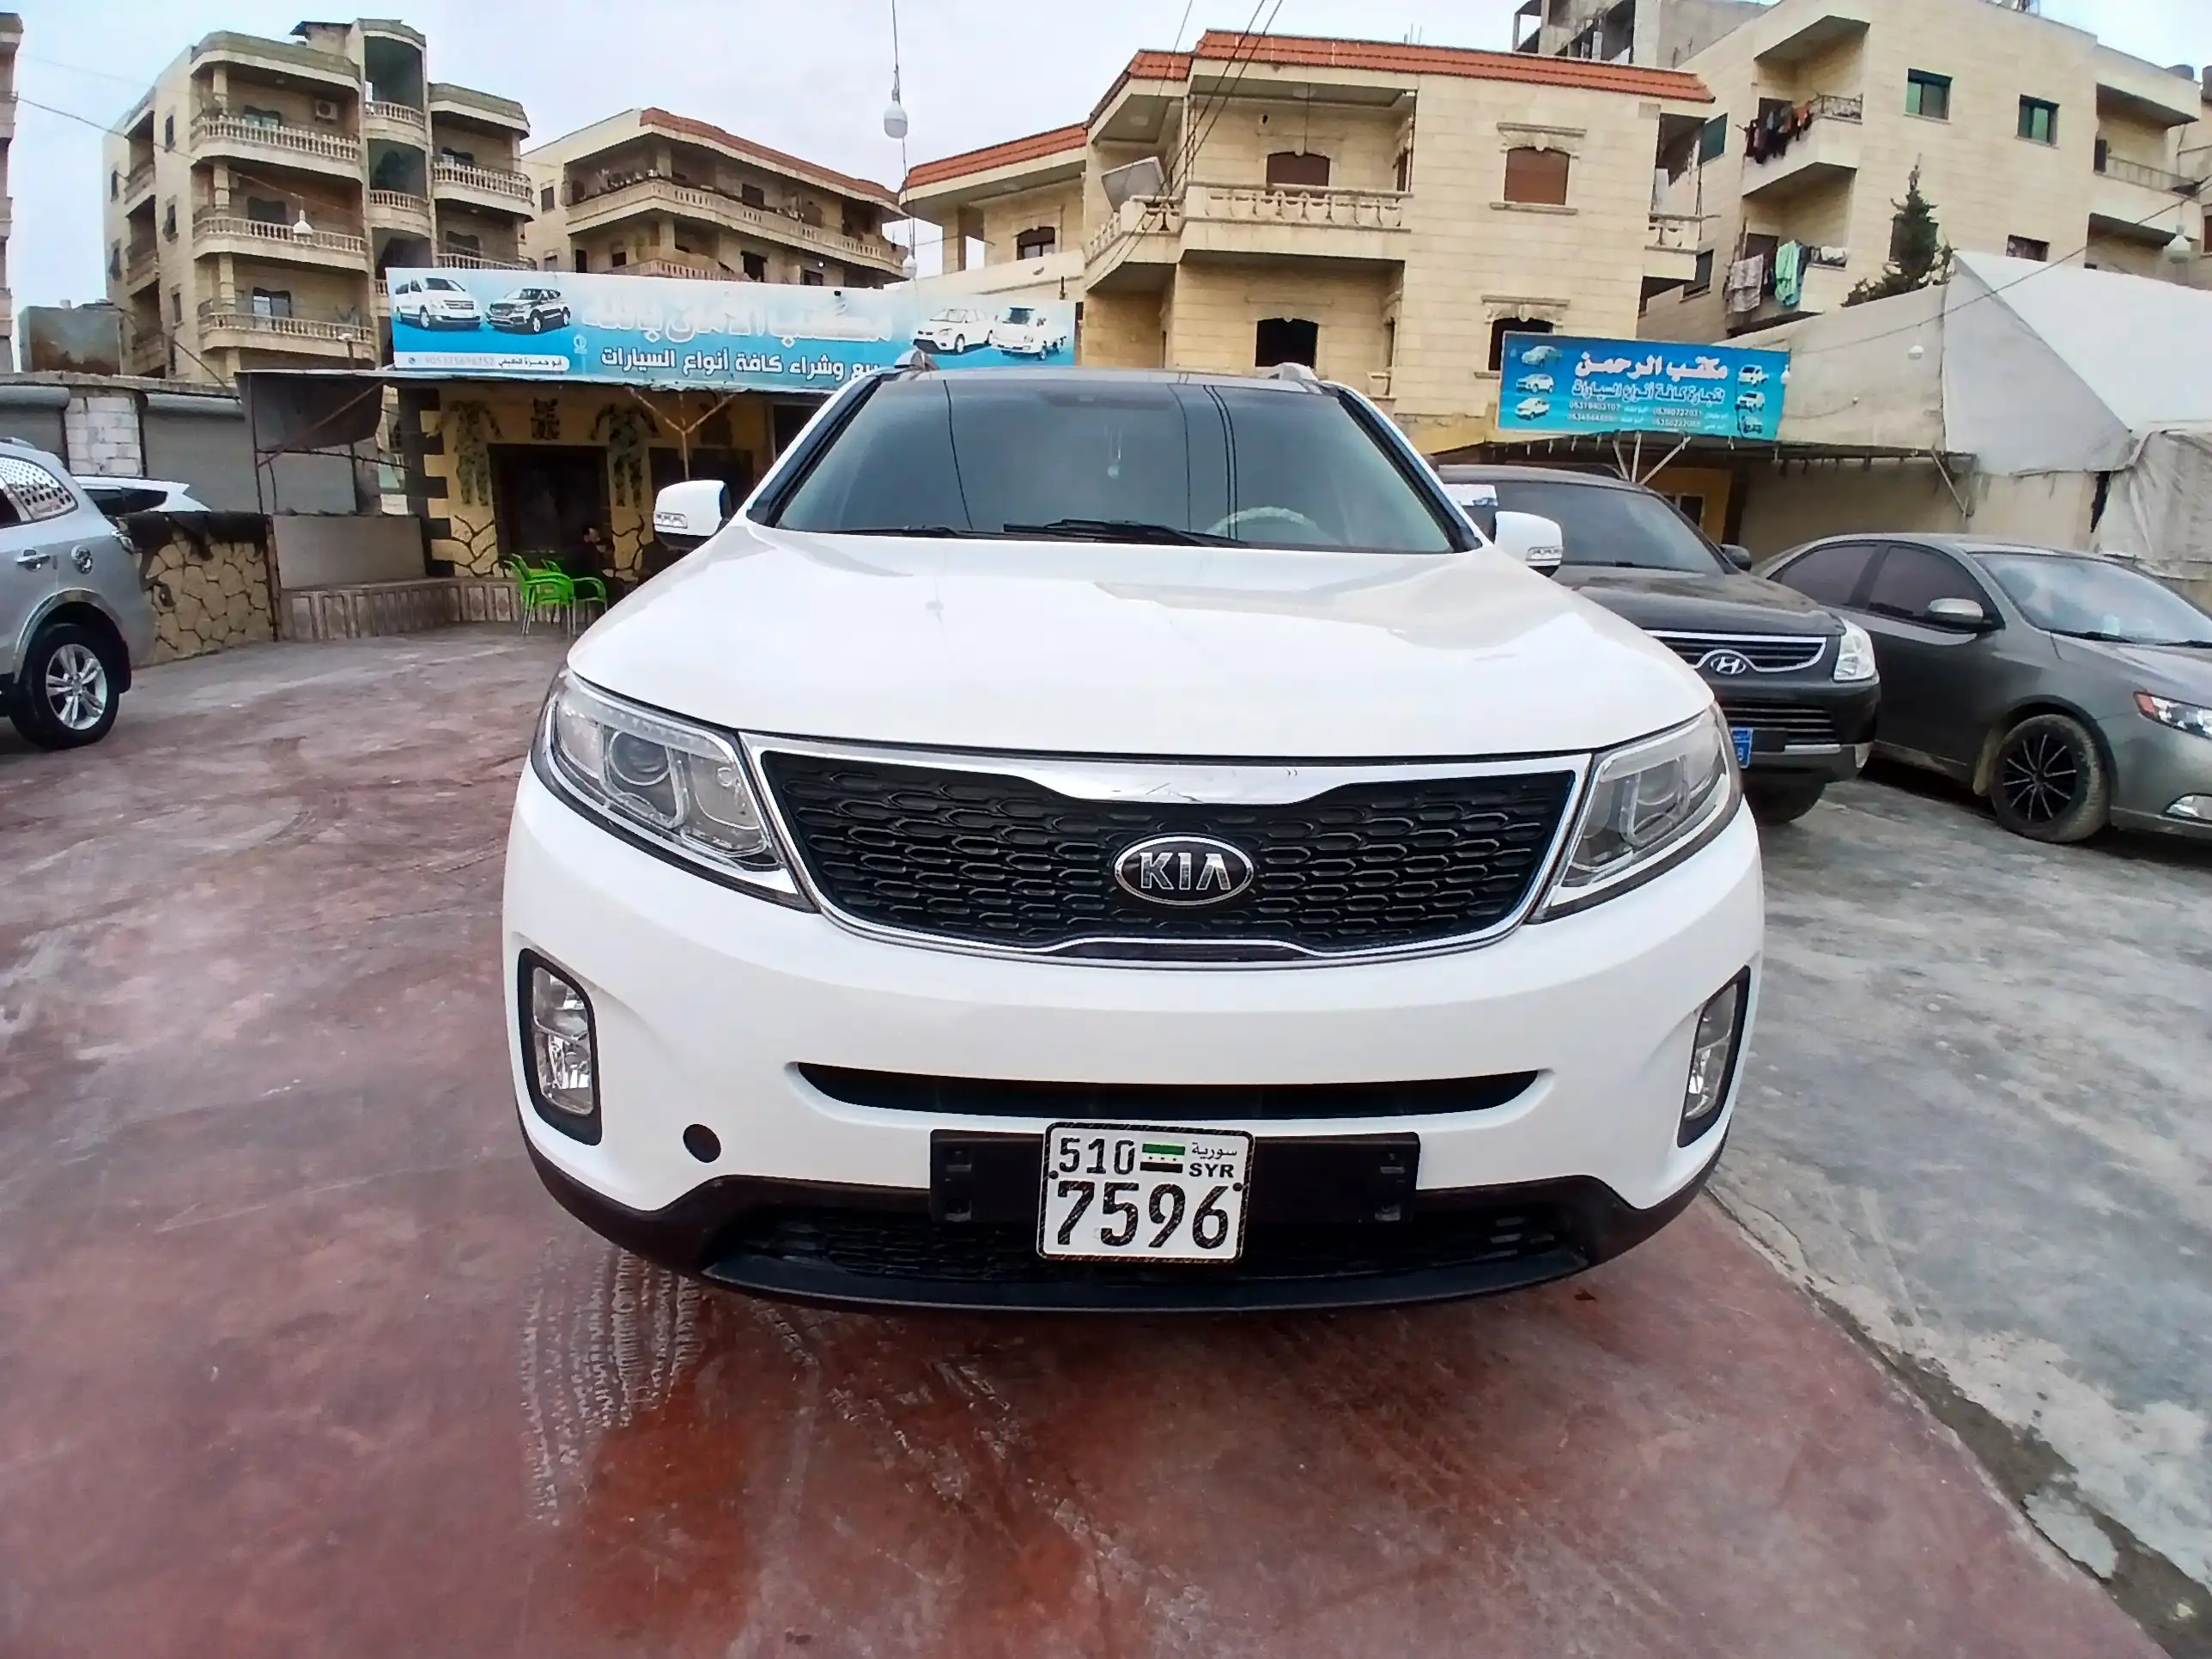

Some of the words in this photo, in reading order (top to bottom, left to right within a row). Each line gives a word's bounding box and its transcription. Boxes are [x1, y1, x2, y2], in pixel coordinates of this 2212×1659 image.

[600, 347, 676, 371] السيارات
[682, 347, 730, 376] أنواع
[734, 351, 784, 374] كافة
[788, 354, 845, 382] وشراء
[1574, 350, 1663, 380] الرحمن
[1666, 355, 1729, 382] مكتب
[1571, 379, 1623, 400] السيارات
[1655, 382, 1688, 402] كافة
[1139, 852, 1231, 890] KIA
[1058, 1137, 1135, 1176] 510
[1191, 1141, 1237, 1160] سورية
[1188, 1162, 1235, 1178] SYR
[1057, 1180, 1229, 1249] 7596
